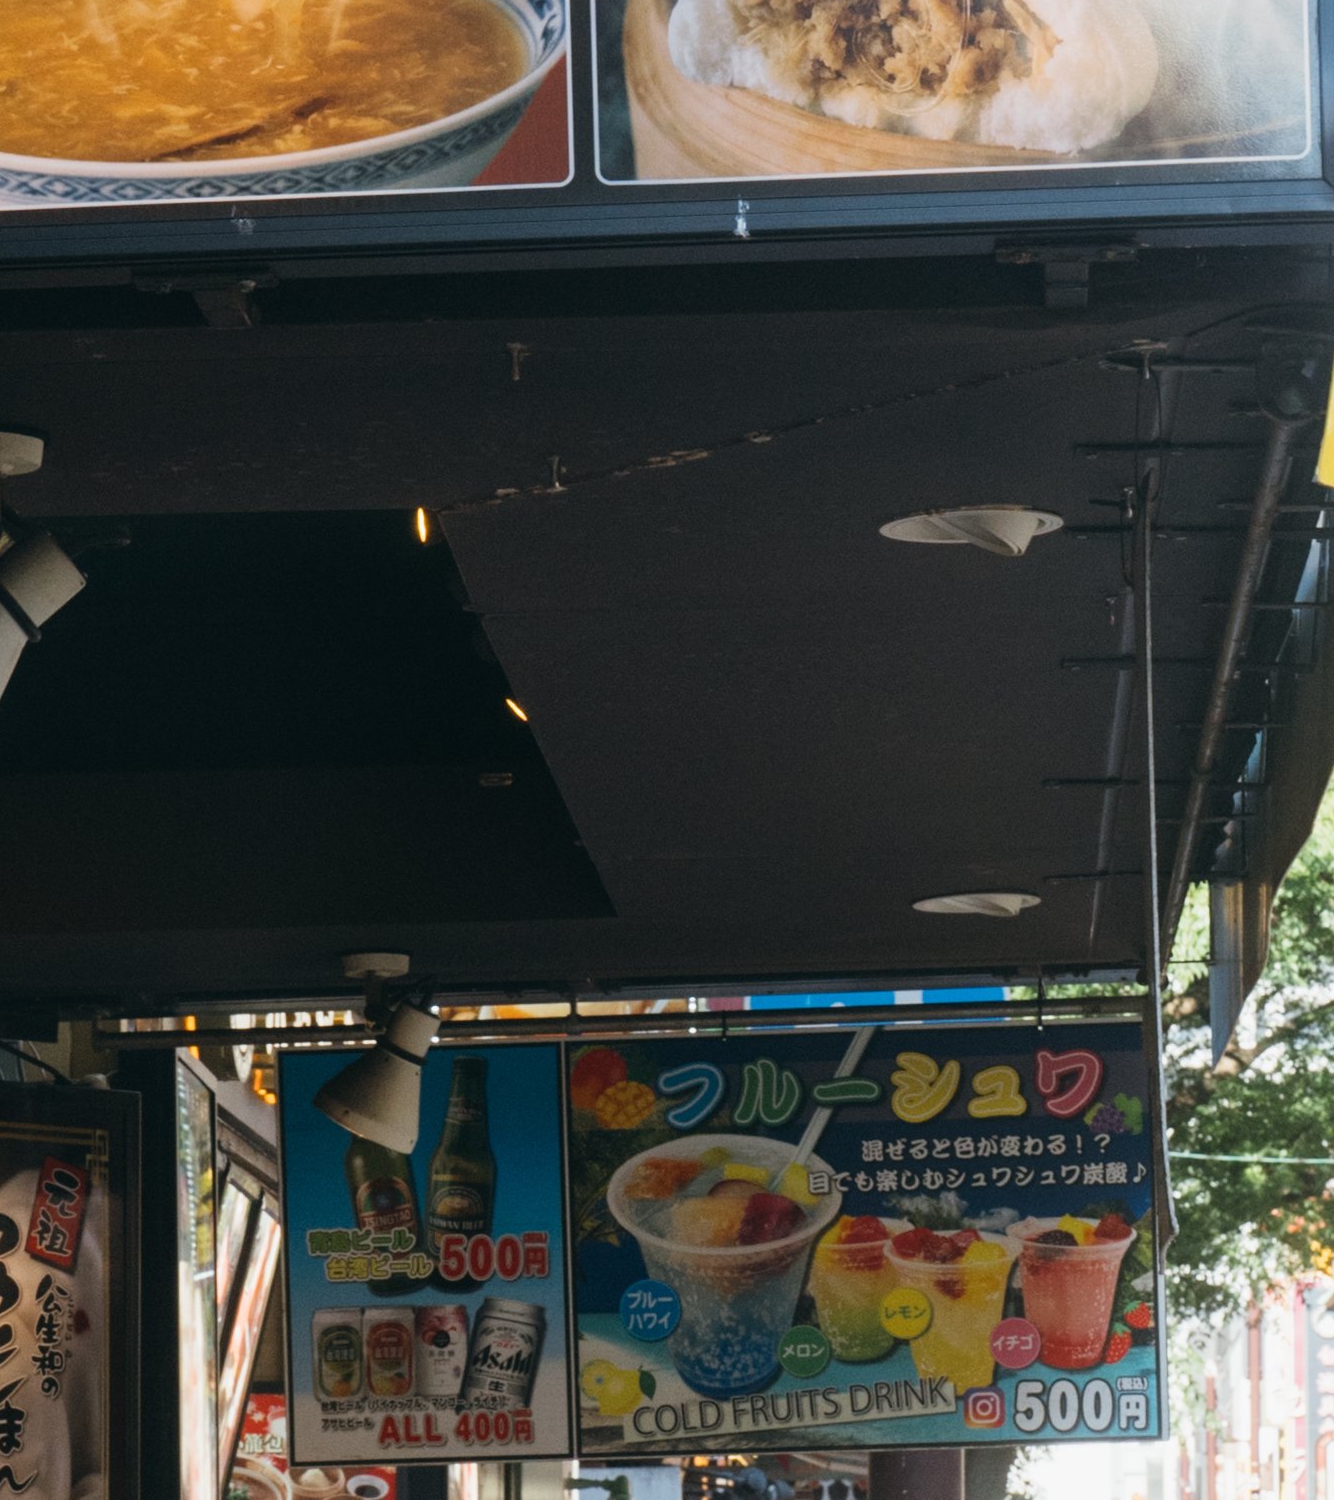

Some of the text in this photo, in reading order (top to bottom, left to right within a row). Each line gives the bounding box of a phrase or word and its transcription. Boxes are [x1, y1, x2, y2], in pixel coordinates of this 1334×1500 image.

[325, 1256, 434, 1281] 台湾ビール
[440, 1232, 550, 1280] 500円
[625, 1289, 674, 1311] ブルー
[883, 1303, 927, 1322] レモン
[626, 1311, 671, 1331] ハワイ
[782, 1342, 826, 1360] メロン
[992, 1332, 1035, 1352] イチゴ
[471, 1342, 534, 1377] Asahi
[633, 1376, 950, 1438] COLD FRUITS DRINK
[1014, 1377, 1149, 1436] 500円
[379, 1414, 448, 1445] ALL
